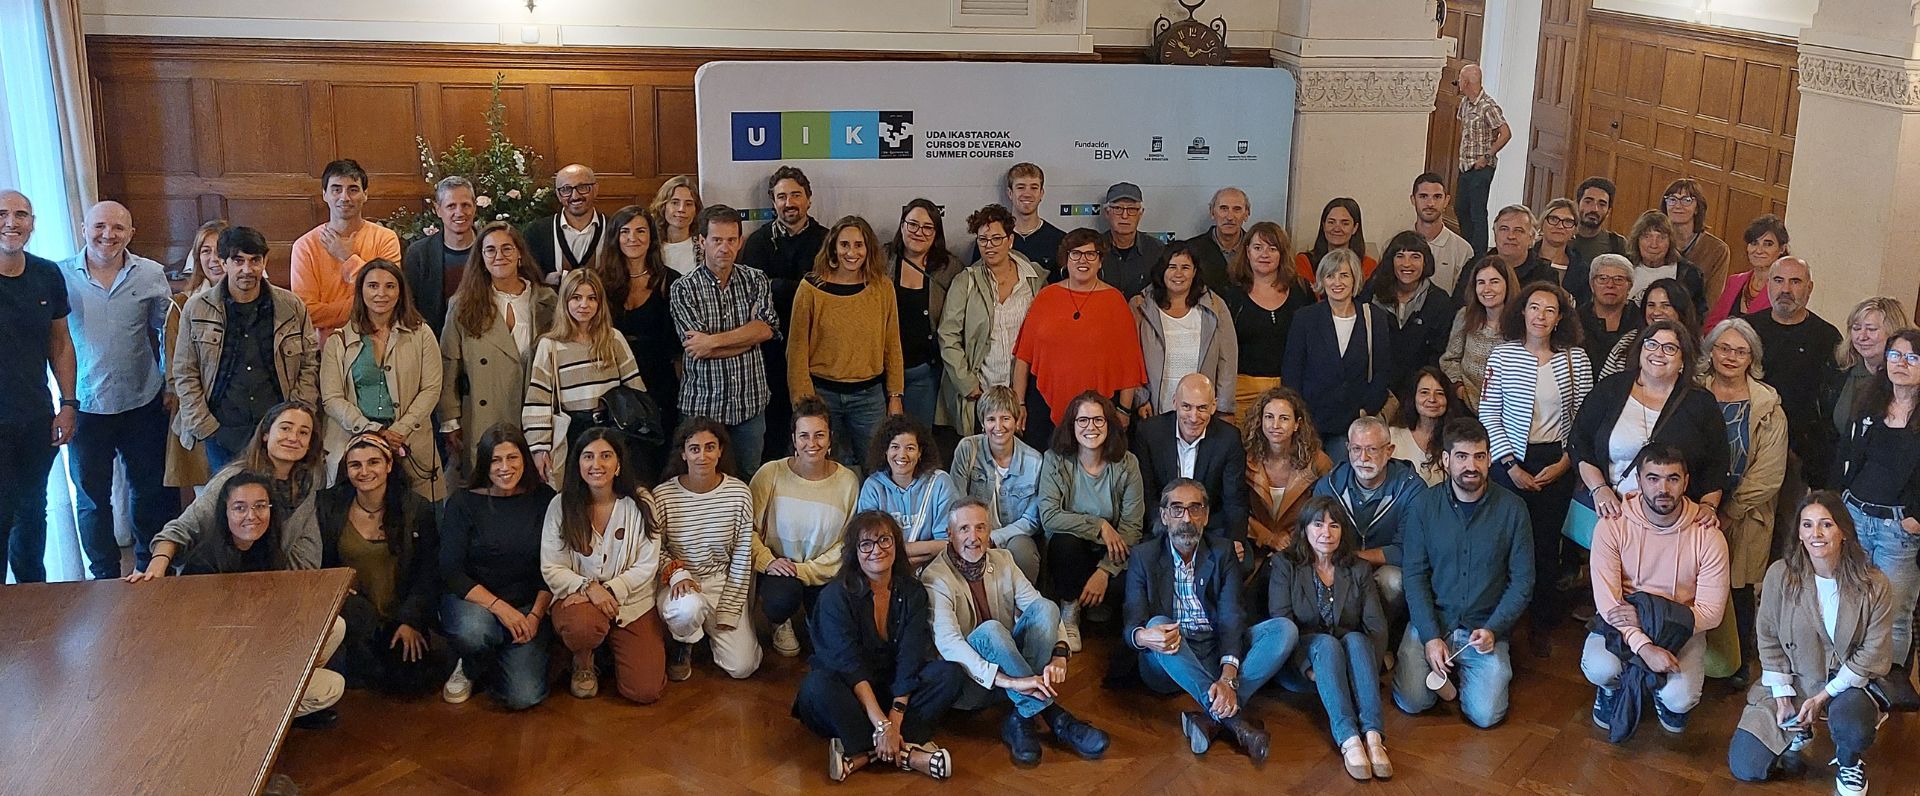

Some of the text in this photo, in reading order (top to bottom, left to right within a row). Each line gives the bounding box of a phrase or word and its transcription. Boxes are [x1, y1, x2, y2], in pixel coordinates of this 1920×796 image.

[926, 131, 1010, 139] UDA IKASTAROAK
[925, 140, 1022, 149] CURSOS DE VERANO
[1074, 140, 1109, 148] Fundación
[925, 150, 1014, 159] SUMMER COURSES
[1095, 149, 1129, 160] BBVA
